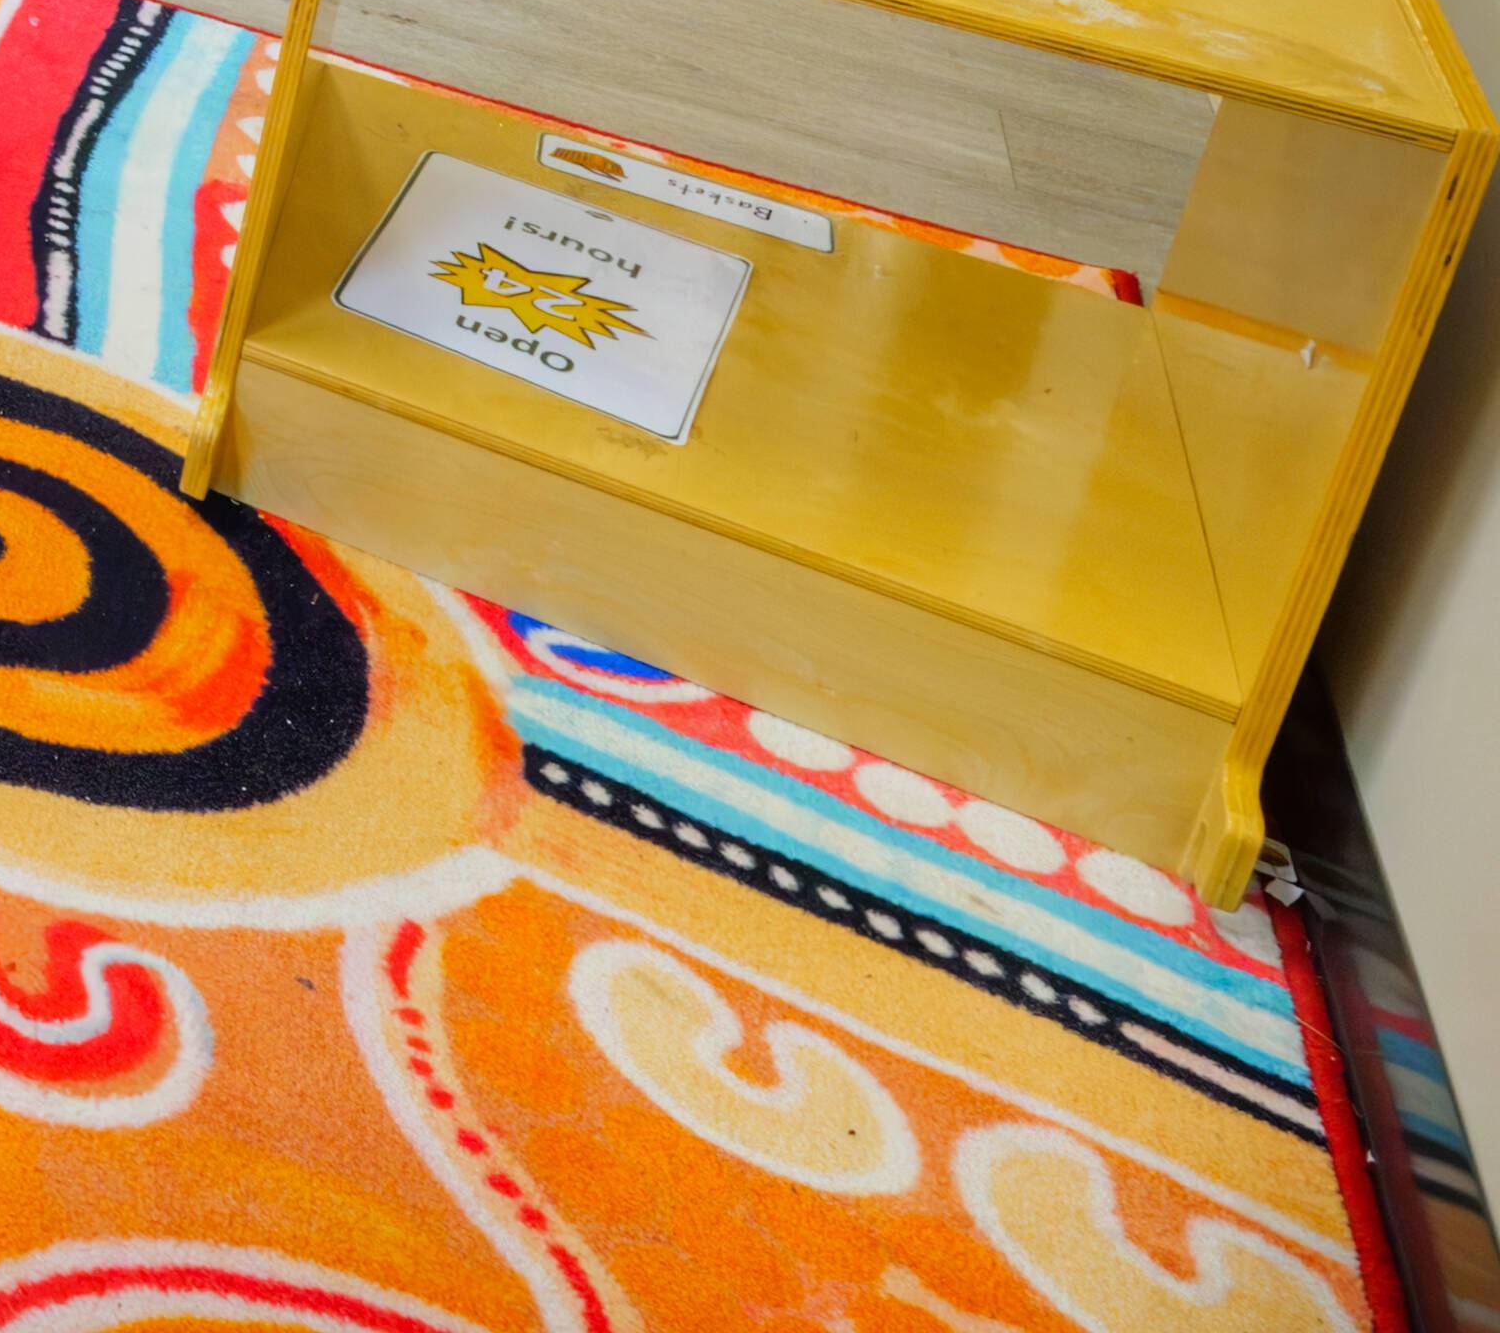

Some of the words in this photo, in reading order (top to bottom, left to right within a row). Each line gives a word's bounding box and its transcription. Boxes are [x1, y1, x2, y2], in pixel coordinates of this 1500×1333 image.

[668, 176, 773, 222] Baskets
[503, 216, 642, 279] hours!
[481, 267, 588, 322] 24
[455, 315, 575, 373] Open
